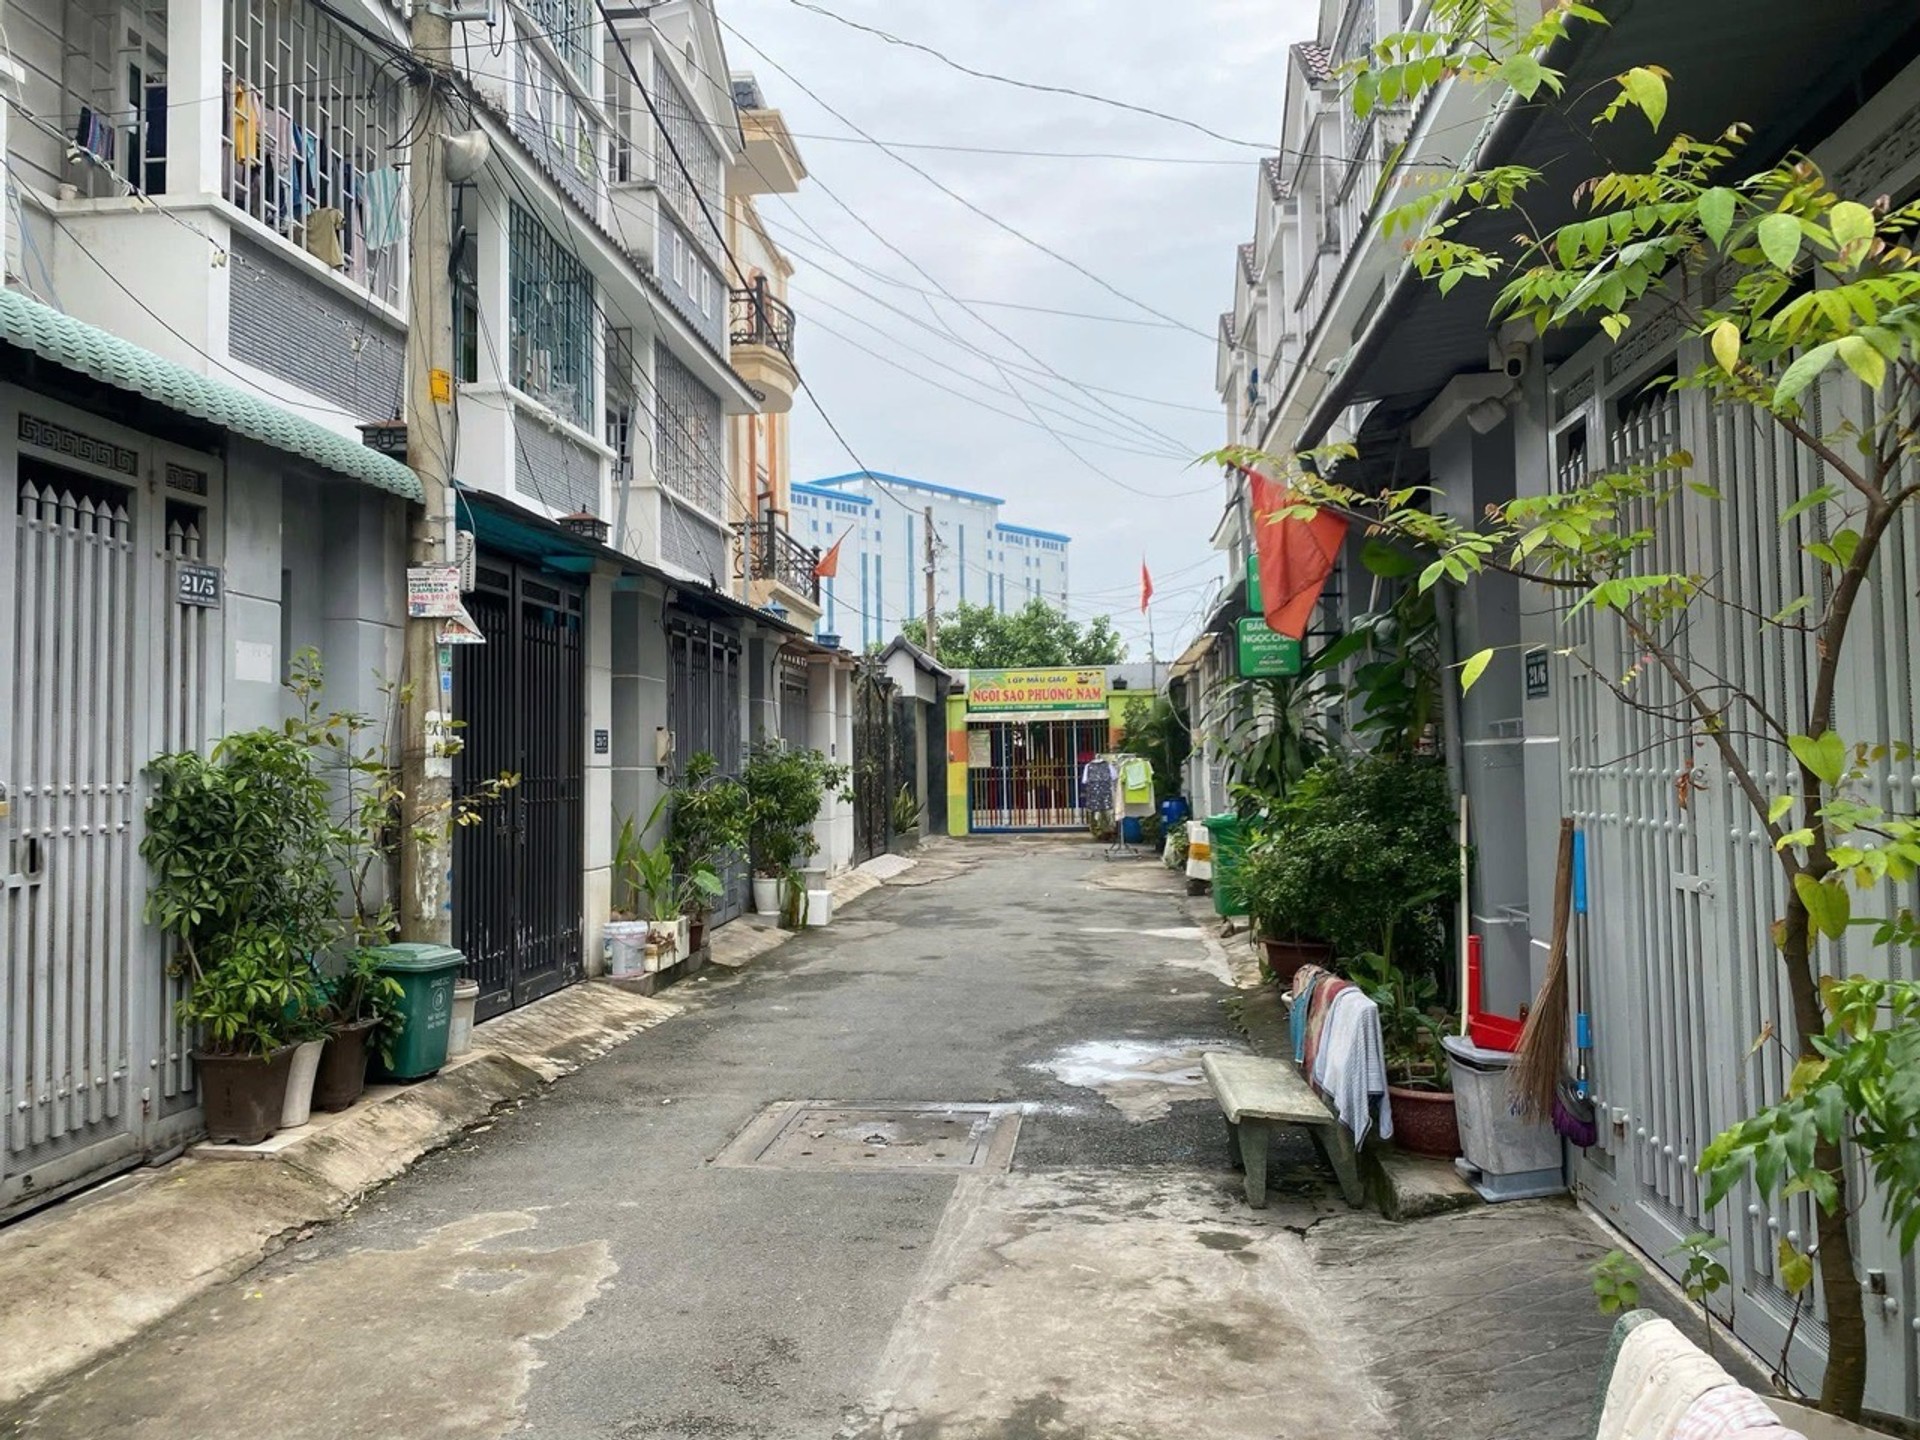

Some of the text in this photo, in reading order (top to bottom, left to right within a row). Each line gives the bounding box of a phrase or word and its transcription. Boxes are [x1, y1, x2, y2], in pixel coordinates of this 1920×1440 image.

[181, 574, 215, 595] 21/5
[1003, 689, 1025, 702] SAO
[1076, 687, 1101, 700] NAM
